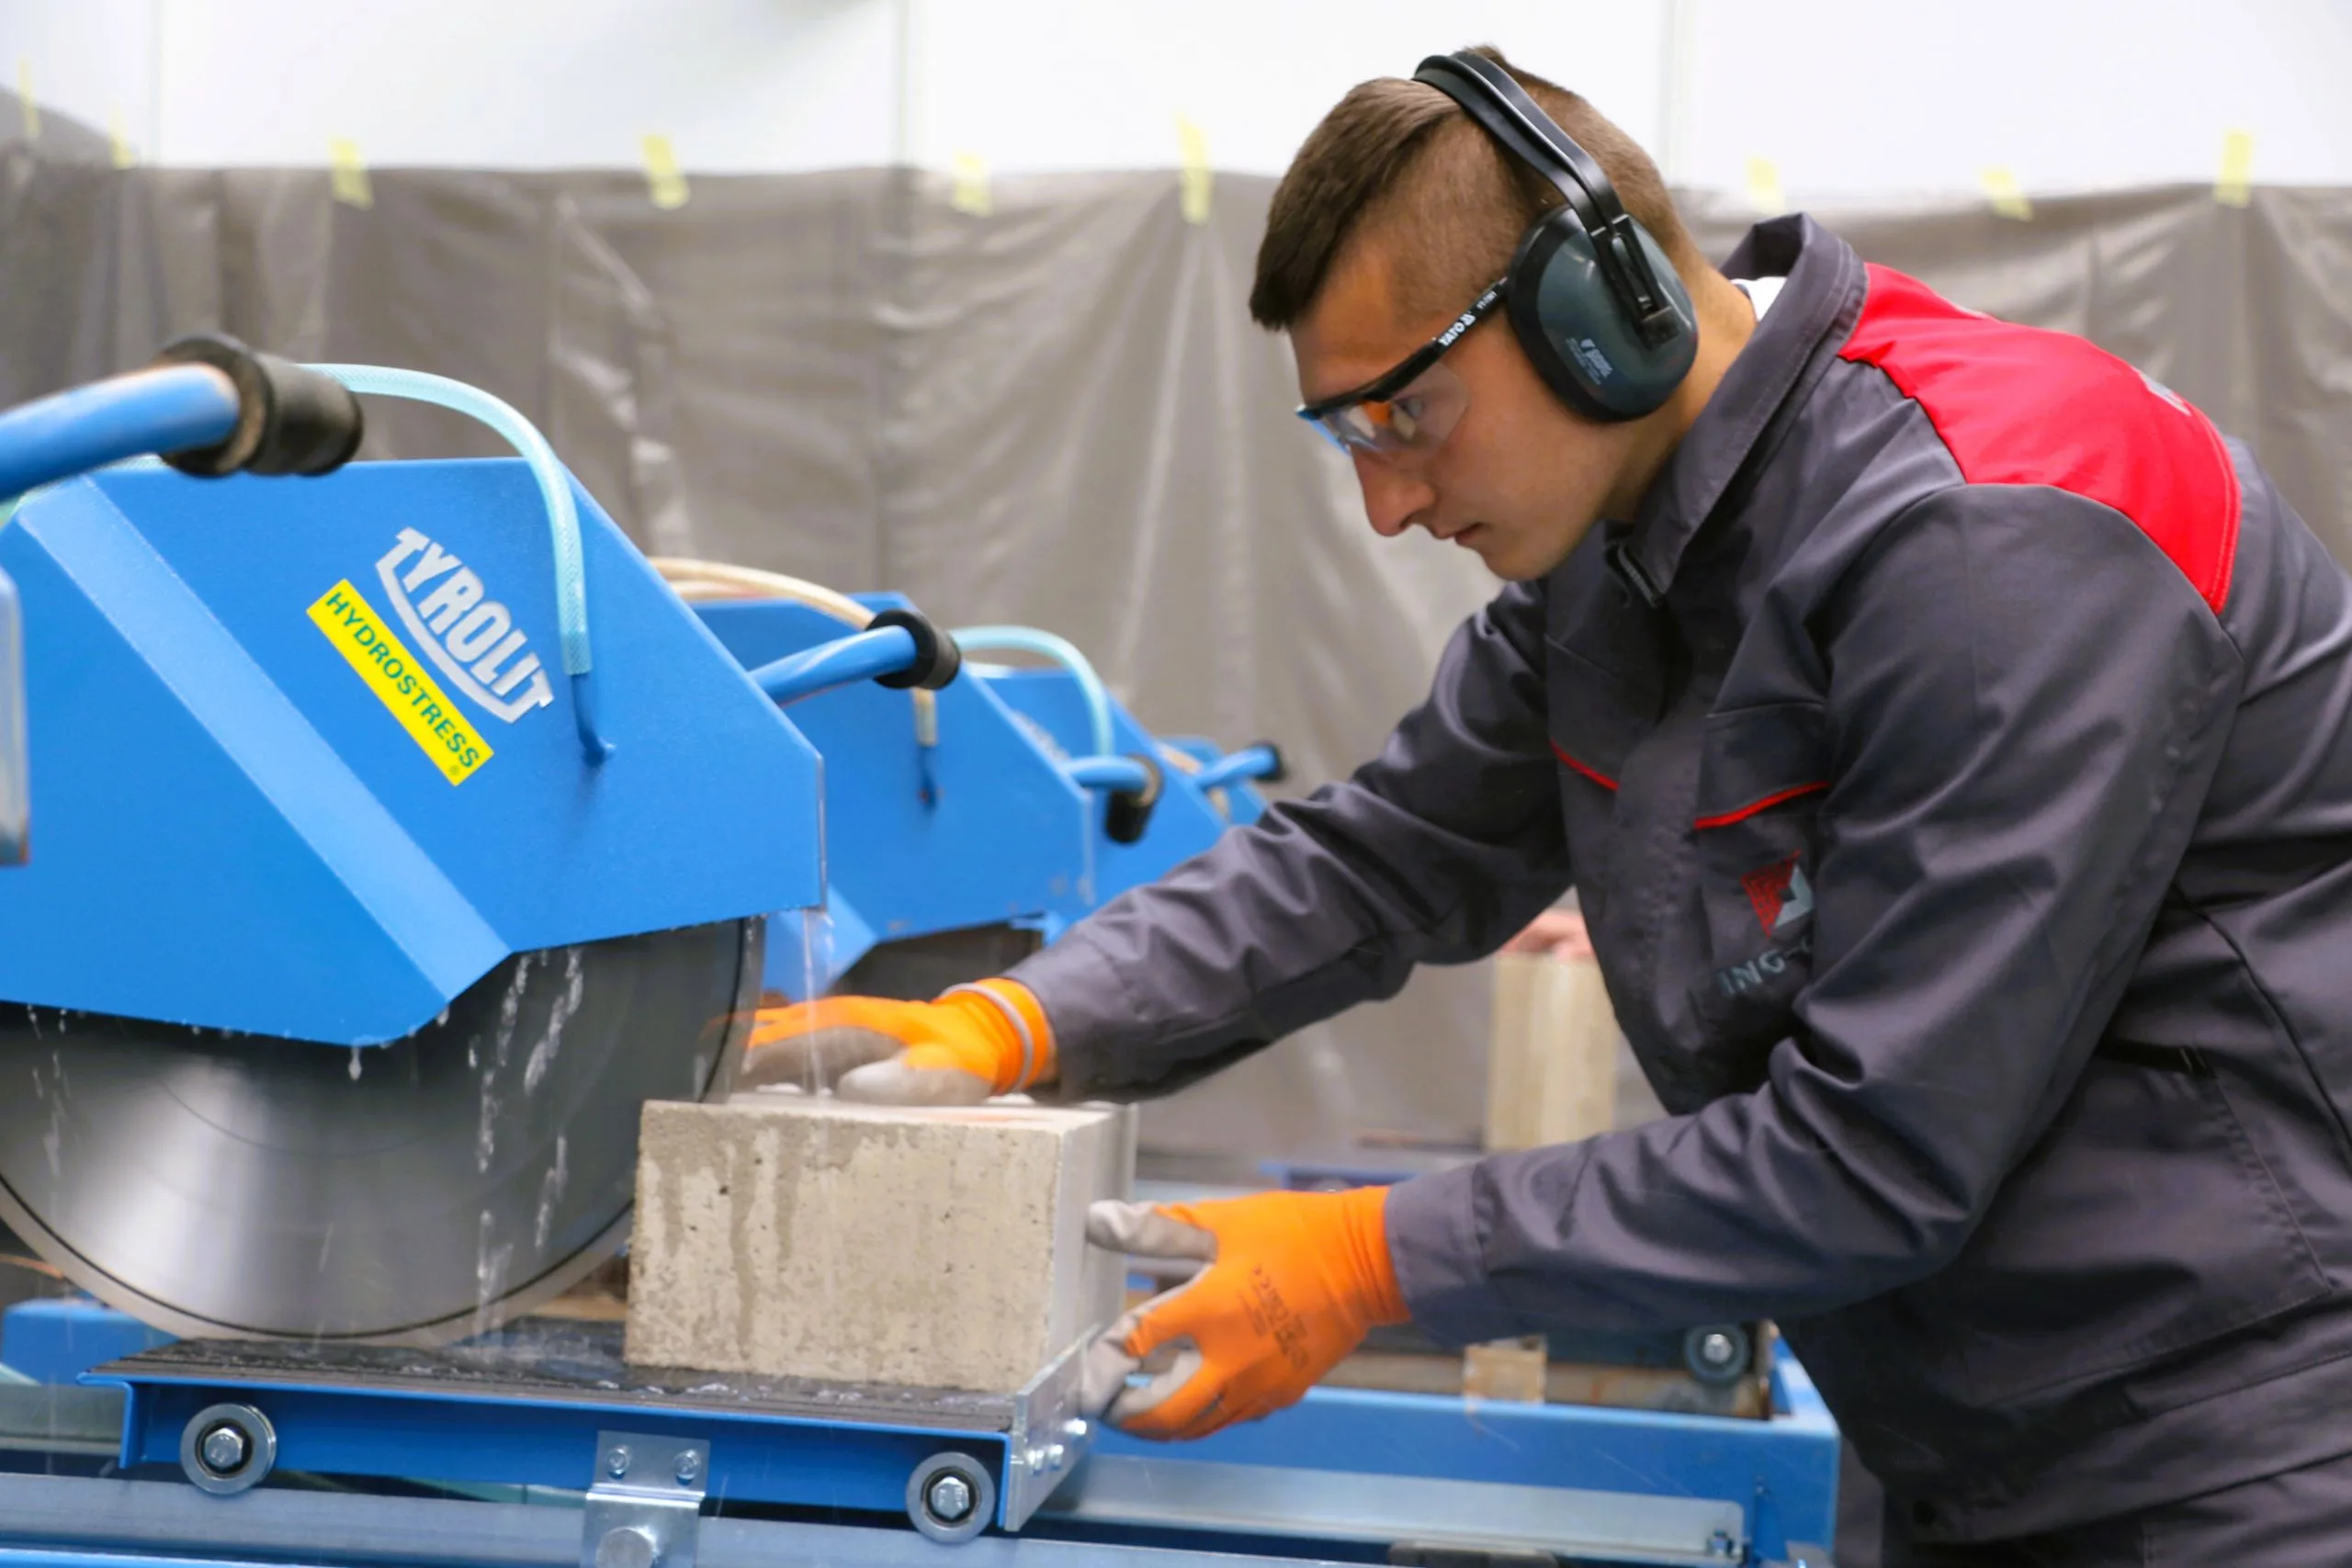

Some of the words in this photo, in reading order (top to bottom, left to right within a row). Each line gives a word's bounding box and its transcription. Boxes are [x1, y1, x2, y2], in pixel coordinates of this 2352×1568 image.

[1438, 321, 1465, 347] YATO
[325, 592, 480, 768] HYDROSTRESS
[375, 526, 554, 724] TYROLIT
[1718, 938, 1810, 995] ING
